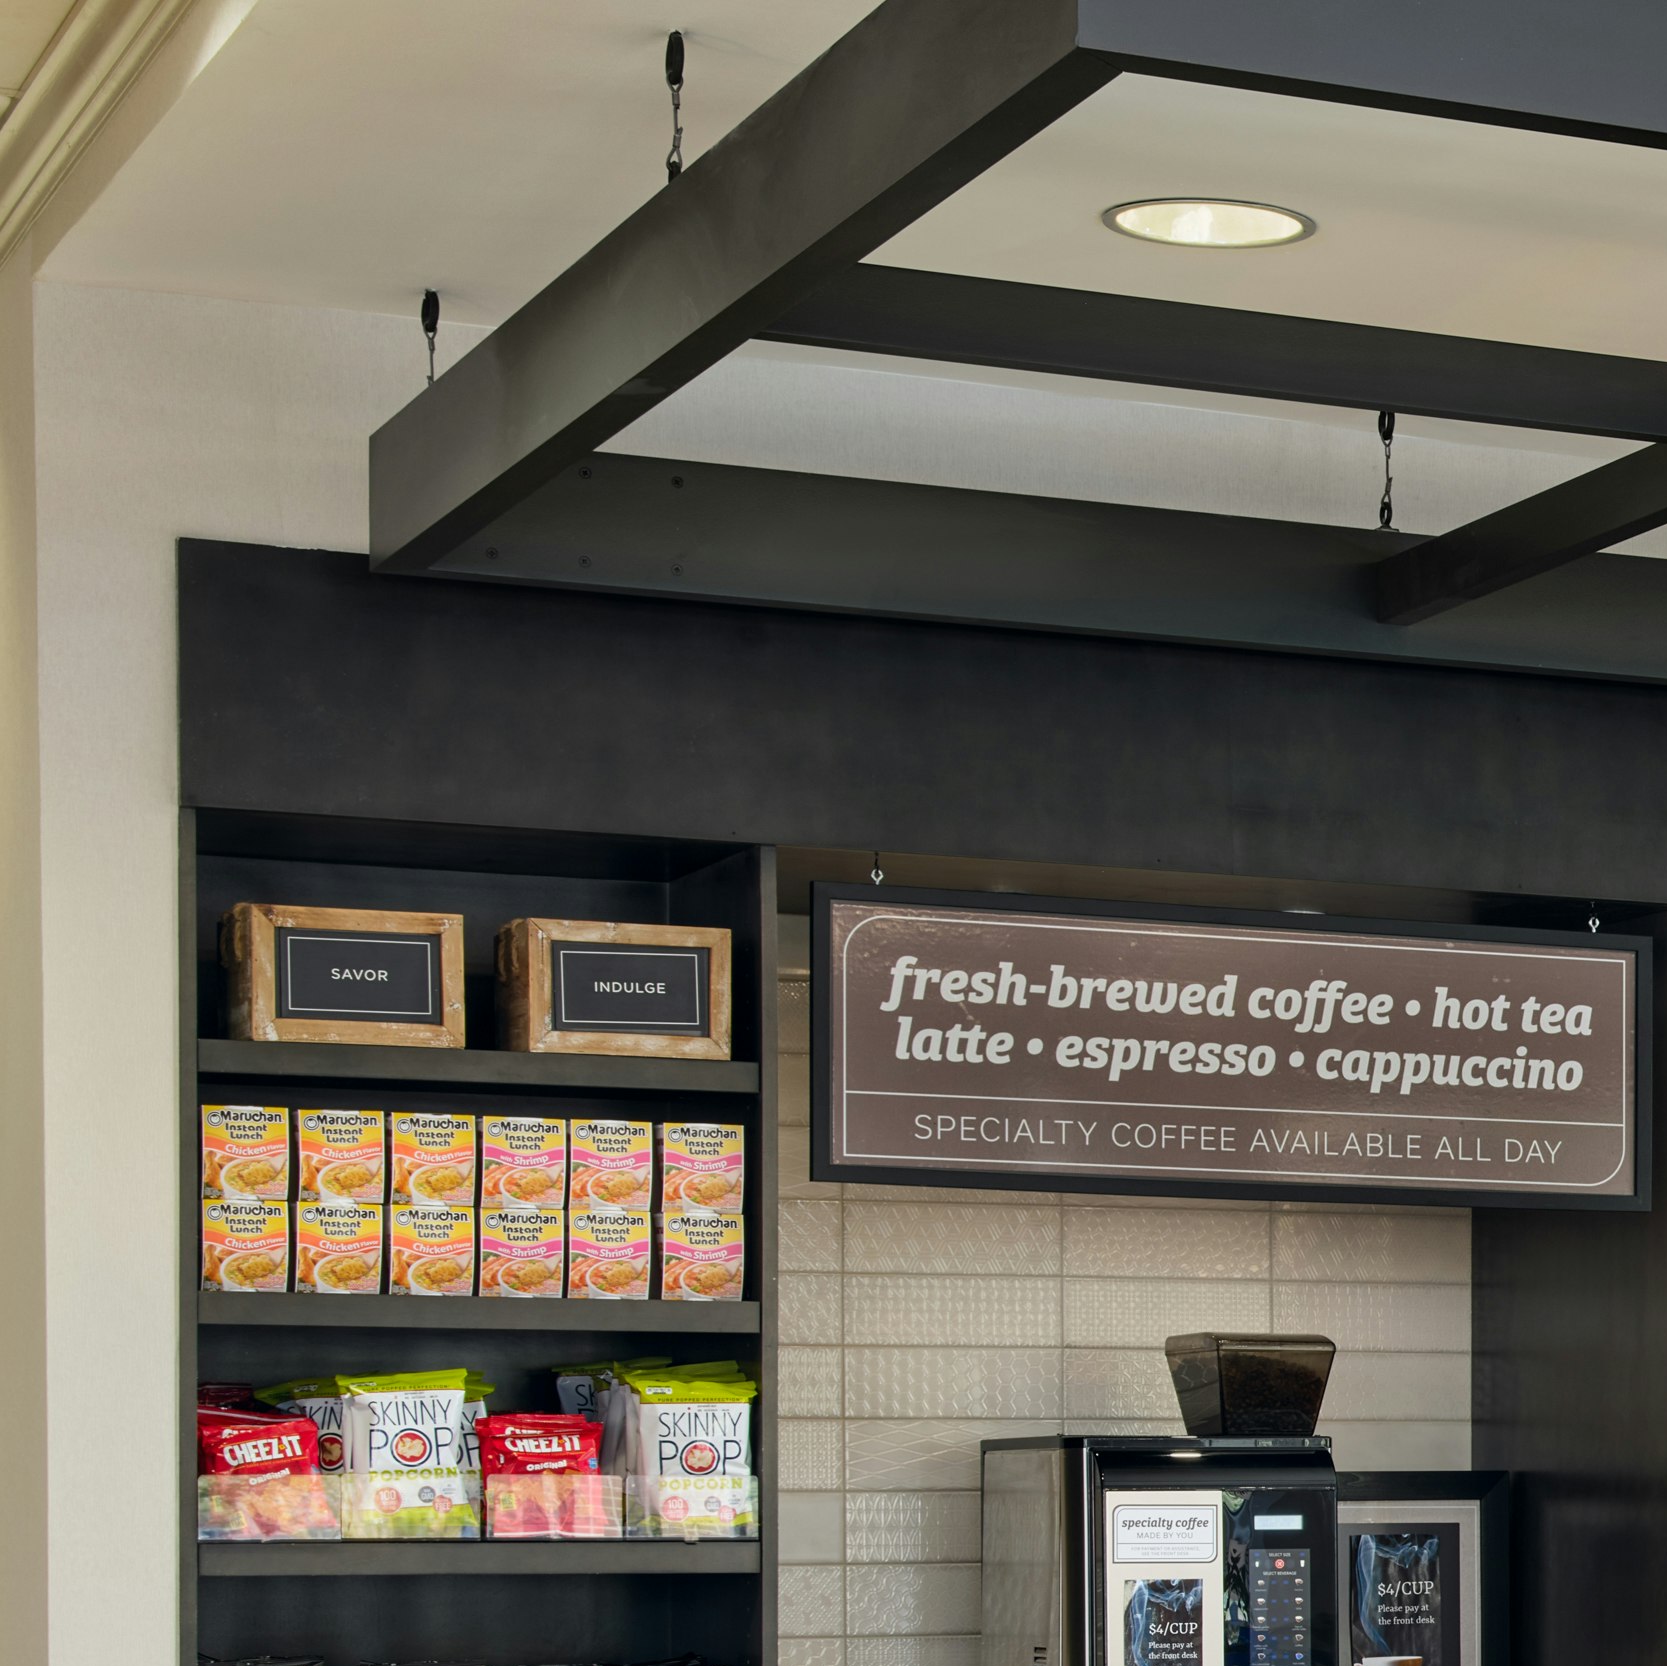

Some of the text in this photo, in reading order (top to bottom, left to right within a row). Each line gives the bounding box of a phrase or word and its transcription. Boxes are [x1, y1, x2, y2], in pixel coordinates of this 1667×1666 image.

[331, 969, 388, 981] SAVOR
[594, 981, 666, 994] INDULGE
[880, 956, 1592, 1036] fresh-brewed coffee hot tea
[895, 1016, 1583, 1095] latte espresso cappuccino
[221, 1111, 283, 1122] Maruchan
[317, 1114, 377, 1126] Maruchan
[225, 1123, 267, 1132] Instant
[409, 1118, 470, 1130] Maruchan
[501, 1122, 559, 1134] Maruchan
[588, 1124, 646, 1136] Maruchan
[230, 1132, 263, 1140] Lunch
[321, 1127, 363, 1135] Instant
[414, 1130, 455, 1139] Instant
[680, 1127, 737, 1139] Maruchan
[326, 1135, 359, 1143] Lunch
[505, 1134, 545, 1142] Instant
[914, 1114, 1562, 1164] SPECIALTY COFFEE AVAILABLE ALL DAY
[225, 1144, 265, 1155] Chicken
[509, 1142, 540, 1150] Lunch
[321, 1148, 362, 1159] Chicken
[513, 1154, 548, 1166] Shrimp
[601, 1157, 635, 1168] Shrimp
[220, 1205, 281, 1216] Maruchan
[369, 1428, 454, 1468] POP
[369, 1467, 458, 1482] POPCORN
[658, 1477, 743, 1491] POPCORN
[1122, 1518, 1209, 1530] specialty coffee
[1378, 1581, 1434, 1597] $4/CUP
[1378, 1605, 1402, 1613] Please
[1405, 1605, 1419, 1614] pay
[1378, 1615, 1435, 1625] the front desk
[1149, 1622, 1198, 1635] $4/CUP
